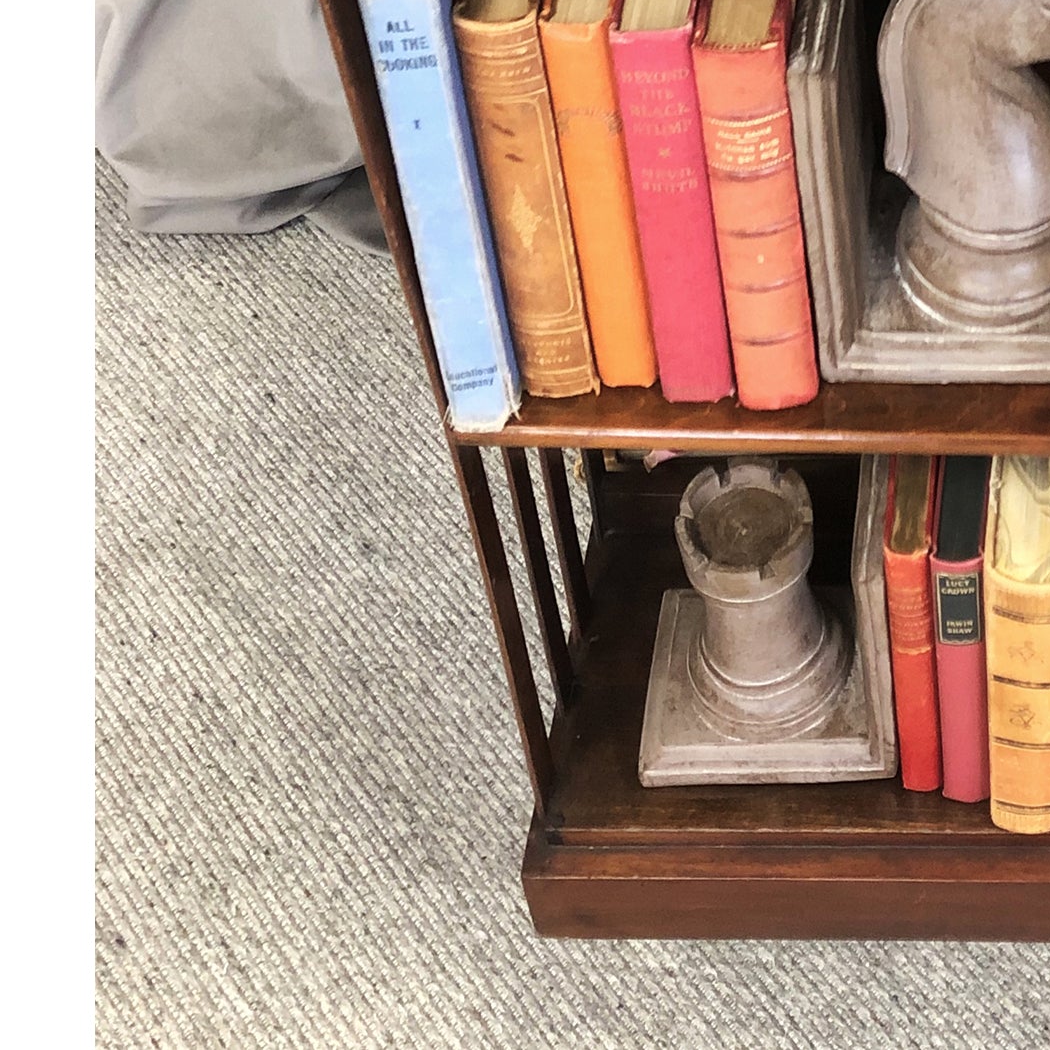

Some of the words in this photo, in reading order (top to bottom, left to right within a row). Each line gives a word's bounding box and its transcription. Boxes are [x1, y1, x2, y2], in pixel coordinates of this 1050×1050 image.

[386, 19, 415, 33] ALL
[378, 39, 394, 52] IN
[400, 36, 430, 51] THE
[450, 377, 494, 393] Company
[945, 579, 970, 588] LUCY
[940, 587, 975, 596] CROWN
